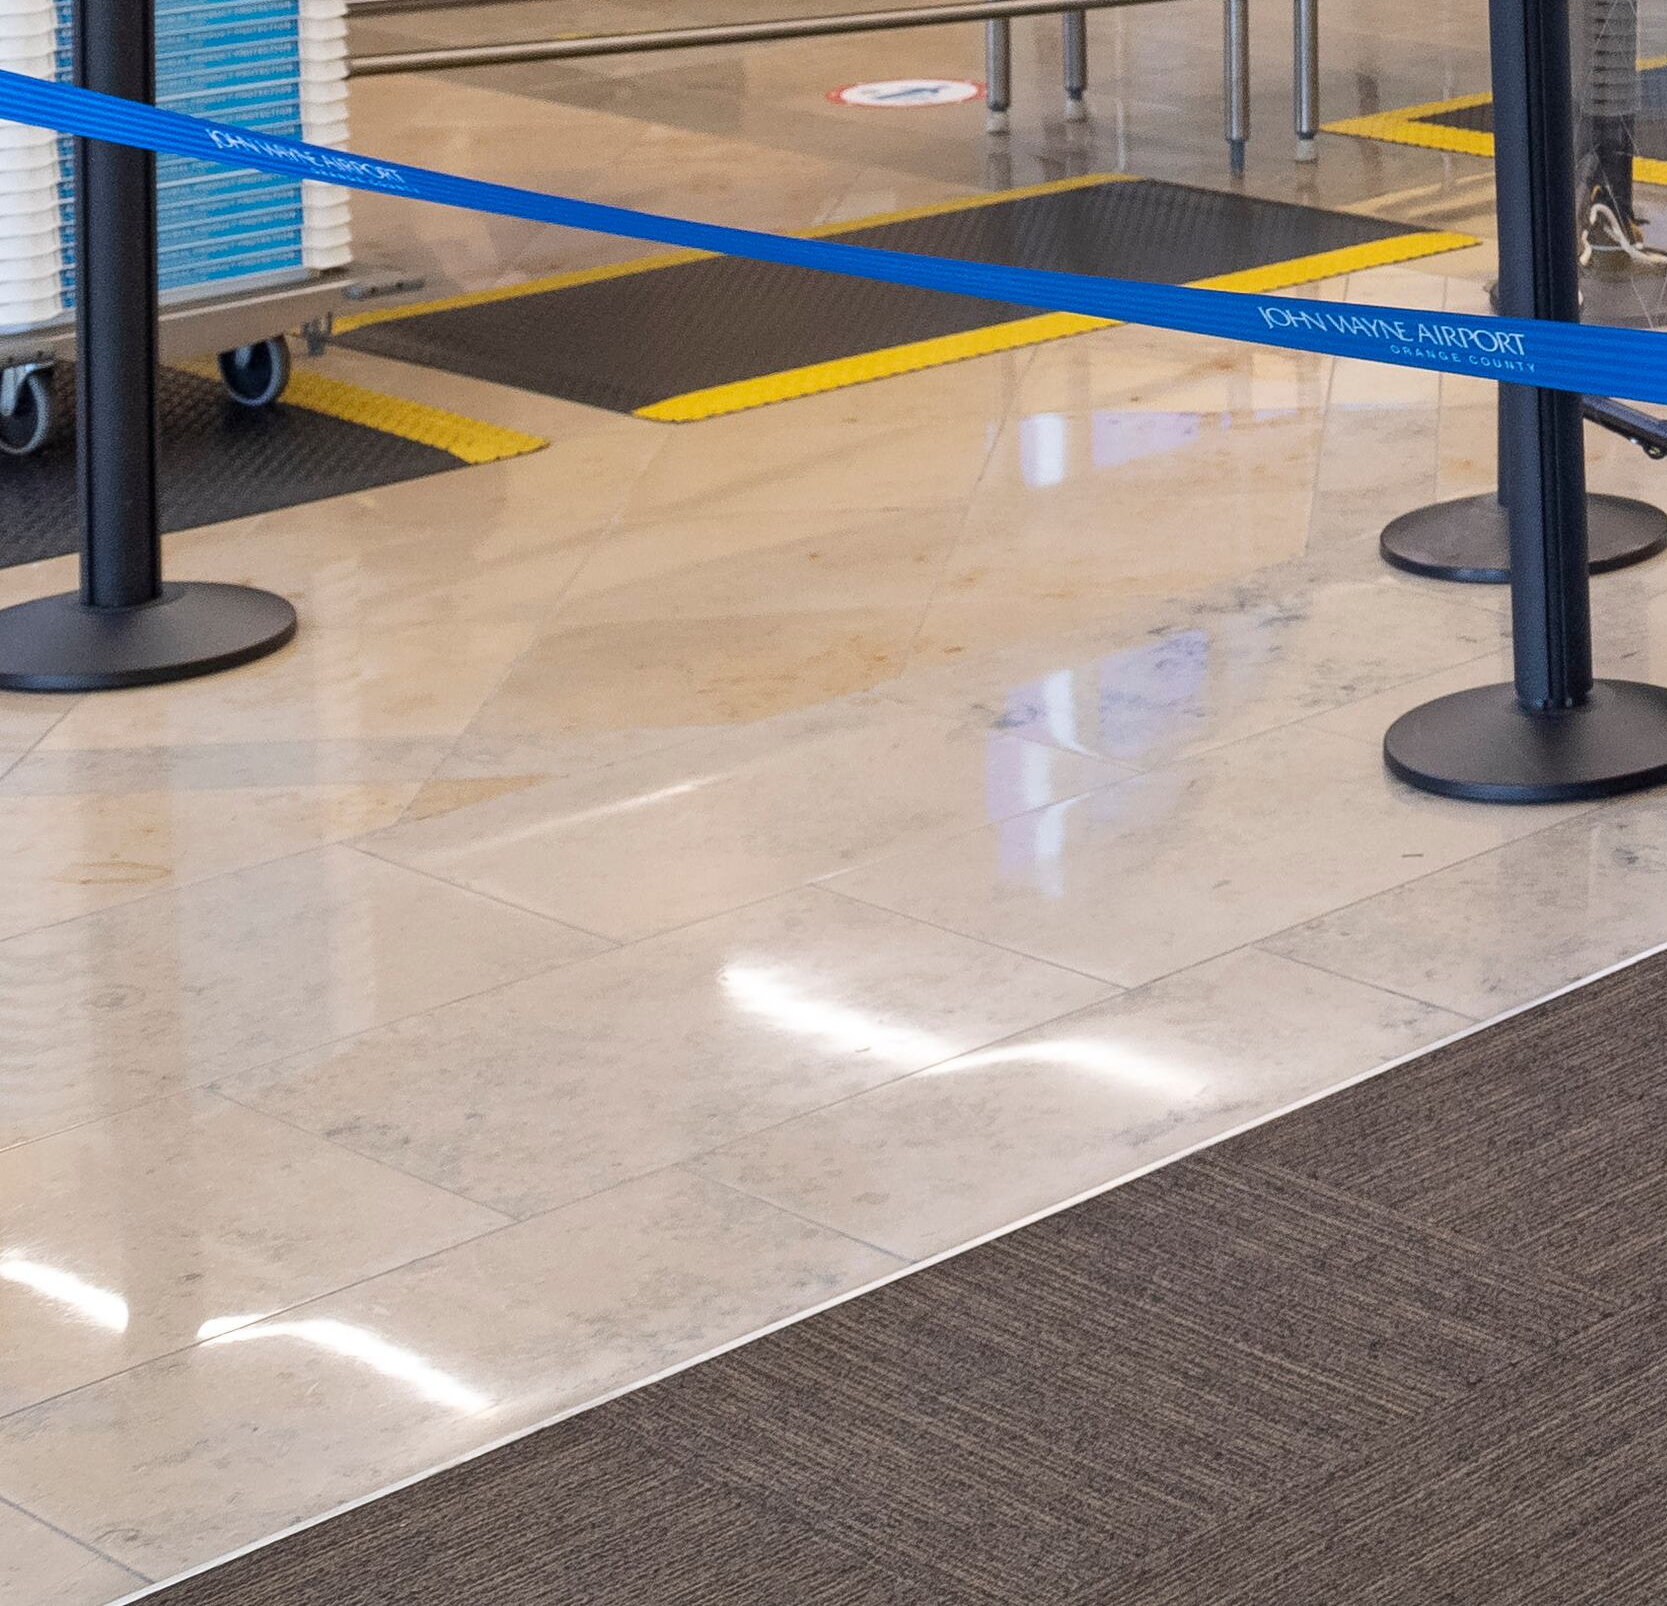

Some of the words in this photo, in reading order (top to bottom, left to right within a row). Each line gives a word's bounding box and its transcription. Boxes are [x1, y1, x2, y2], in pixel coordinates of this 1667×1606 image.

[205, 128, 261, 153] JOHN
[253, 139, 324, 167] WAYNE
[321, 155, 405, 184] AIRPORT
[1258, 306, 1327, 332] JOHN
[1325, 313, 1414, 343] WAYNE
[1418, 323, 1526, 356] AIRPORT
[1390, 344, 1461, 364] ORANGE
[1468, 354, 1536, 374] COUNTY
